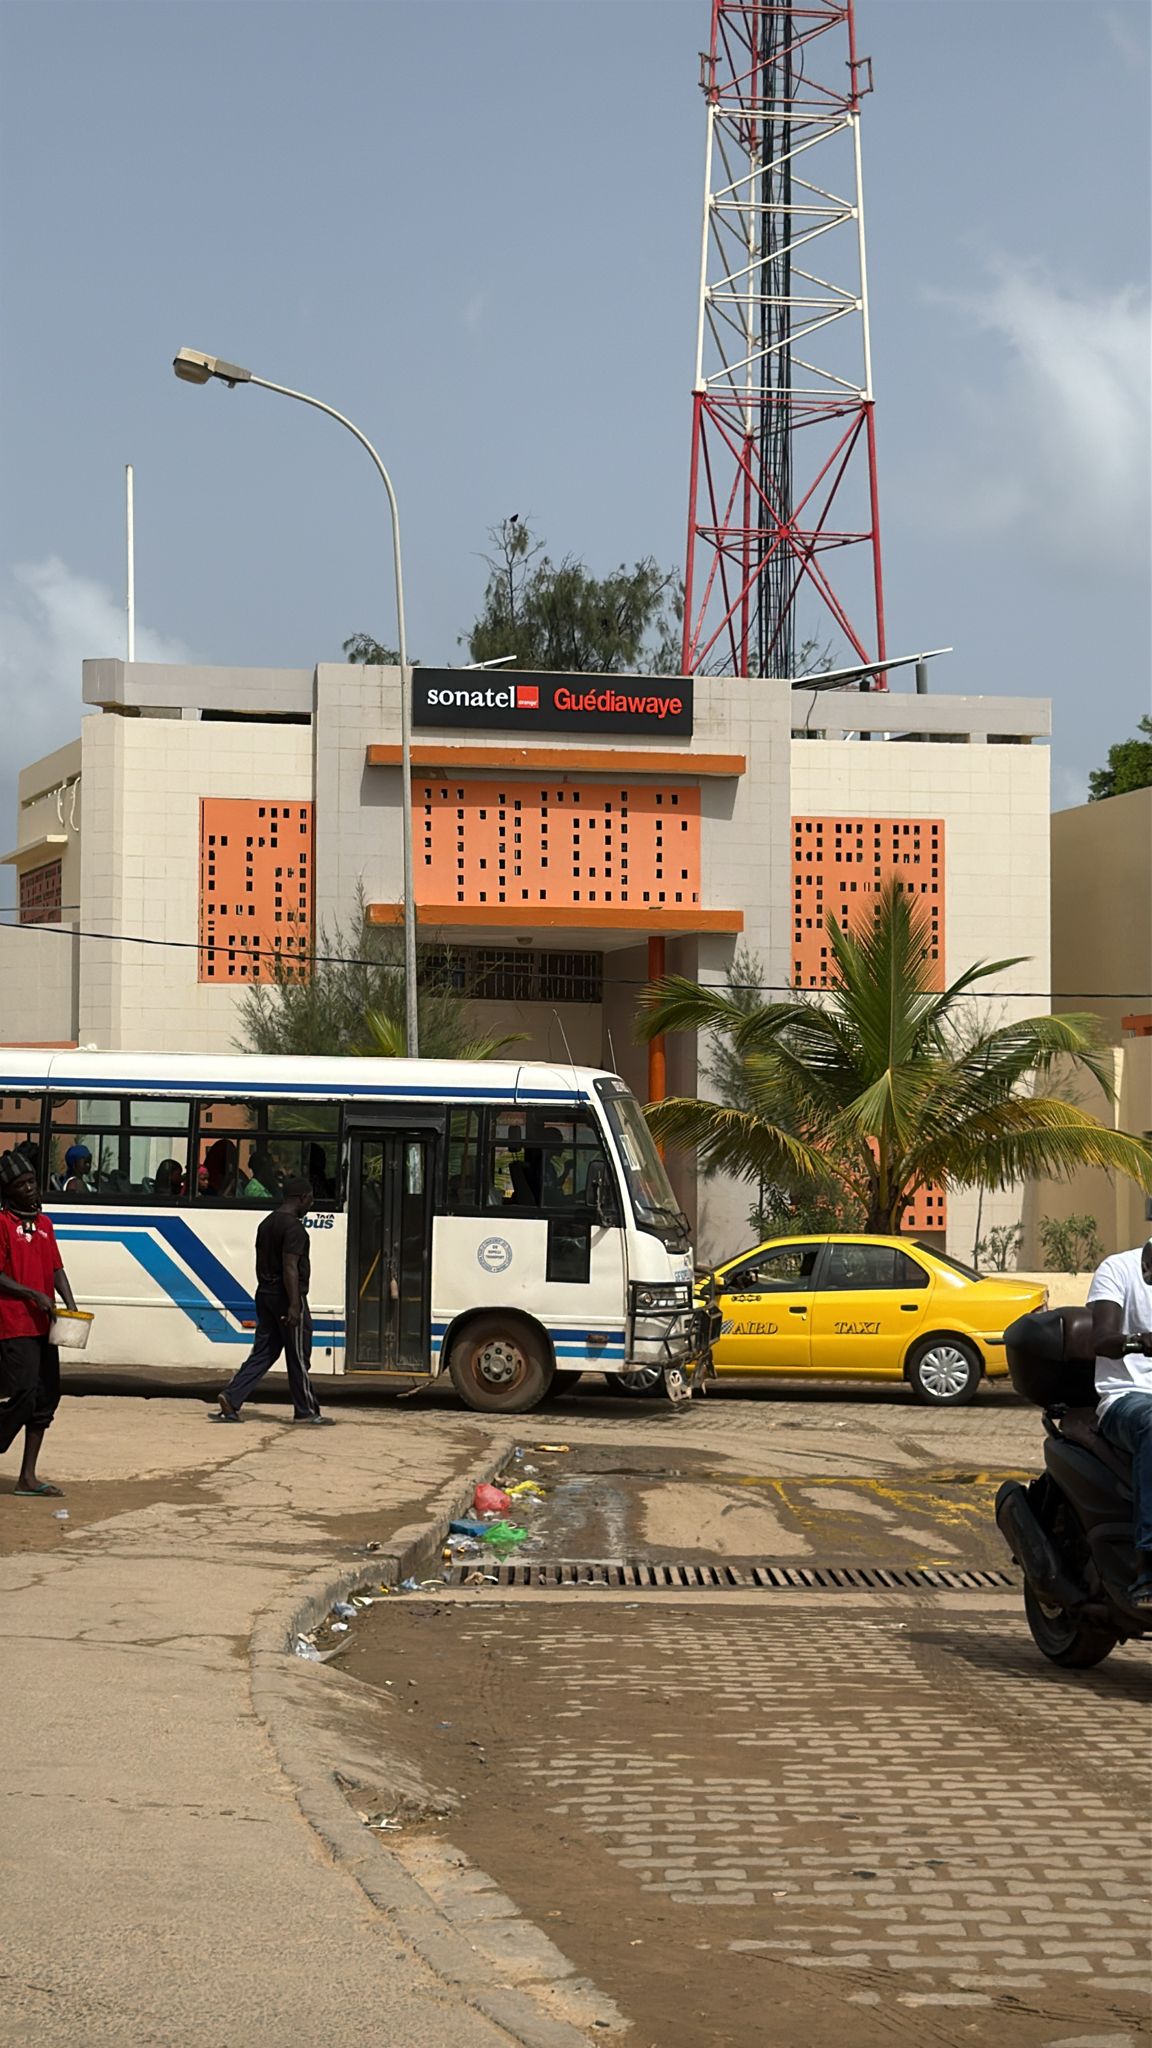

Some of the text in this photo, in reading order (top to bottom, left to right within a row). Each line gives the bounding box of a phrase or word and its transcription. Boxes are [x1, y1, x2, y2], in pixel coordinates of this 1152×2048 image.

[427, 686, 682, 718] sonatel Guédiawaye
[303, 1215, 334, 1229] bus
[834, 1321, 881, 1335] TAXI
